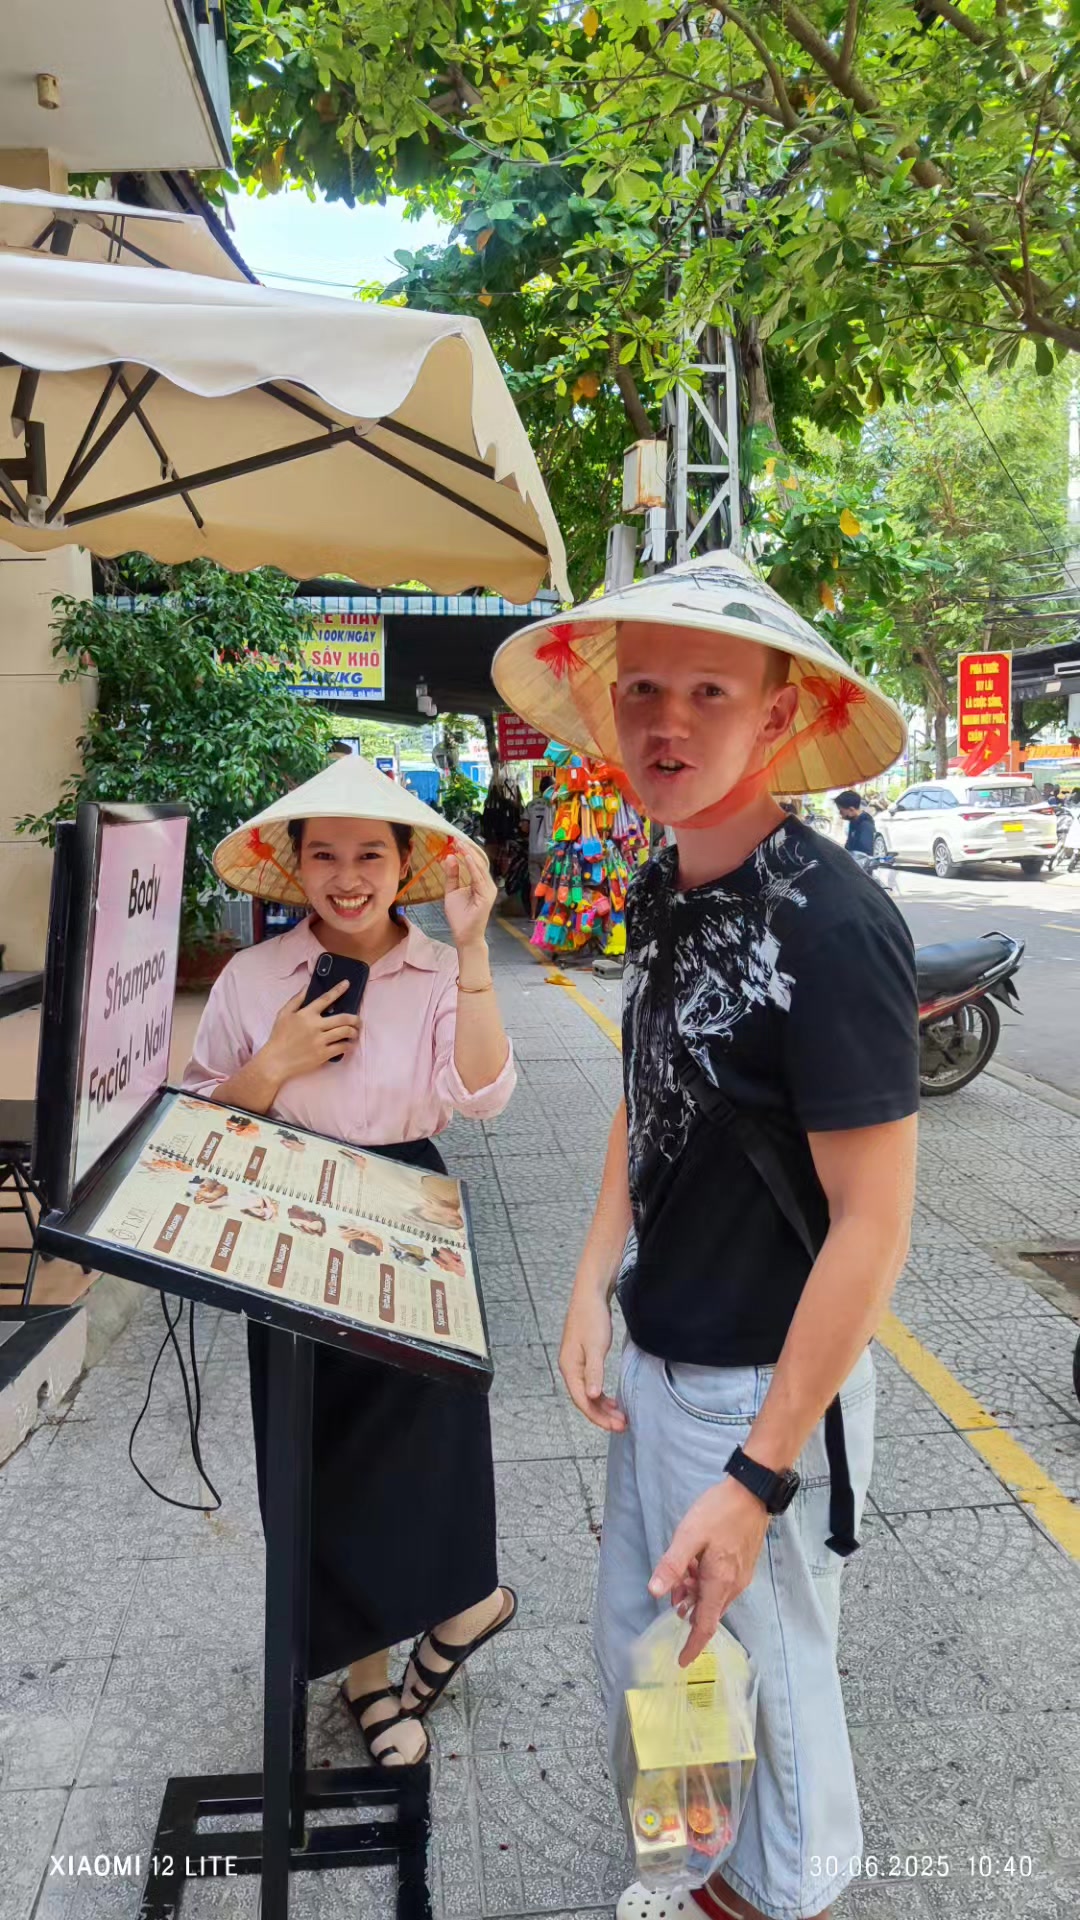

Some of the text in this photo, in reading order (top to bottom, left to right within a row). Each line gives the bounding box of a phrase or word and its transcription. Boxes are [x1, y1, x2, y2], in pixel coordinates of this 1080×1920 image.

[348, 650, 380, 667] KHÔ
[536, 815, 545, 834] 7
[127, 864, 161, 921] Body
[103, 948, 166, 1021] Shampoo
[87, 1036, 132, 1121] Facial
[143, 1005, 168, 1068] Nail
